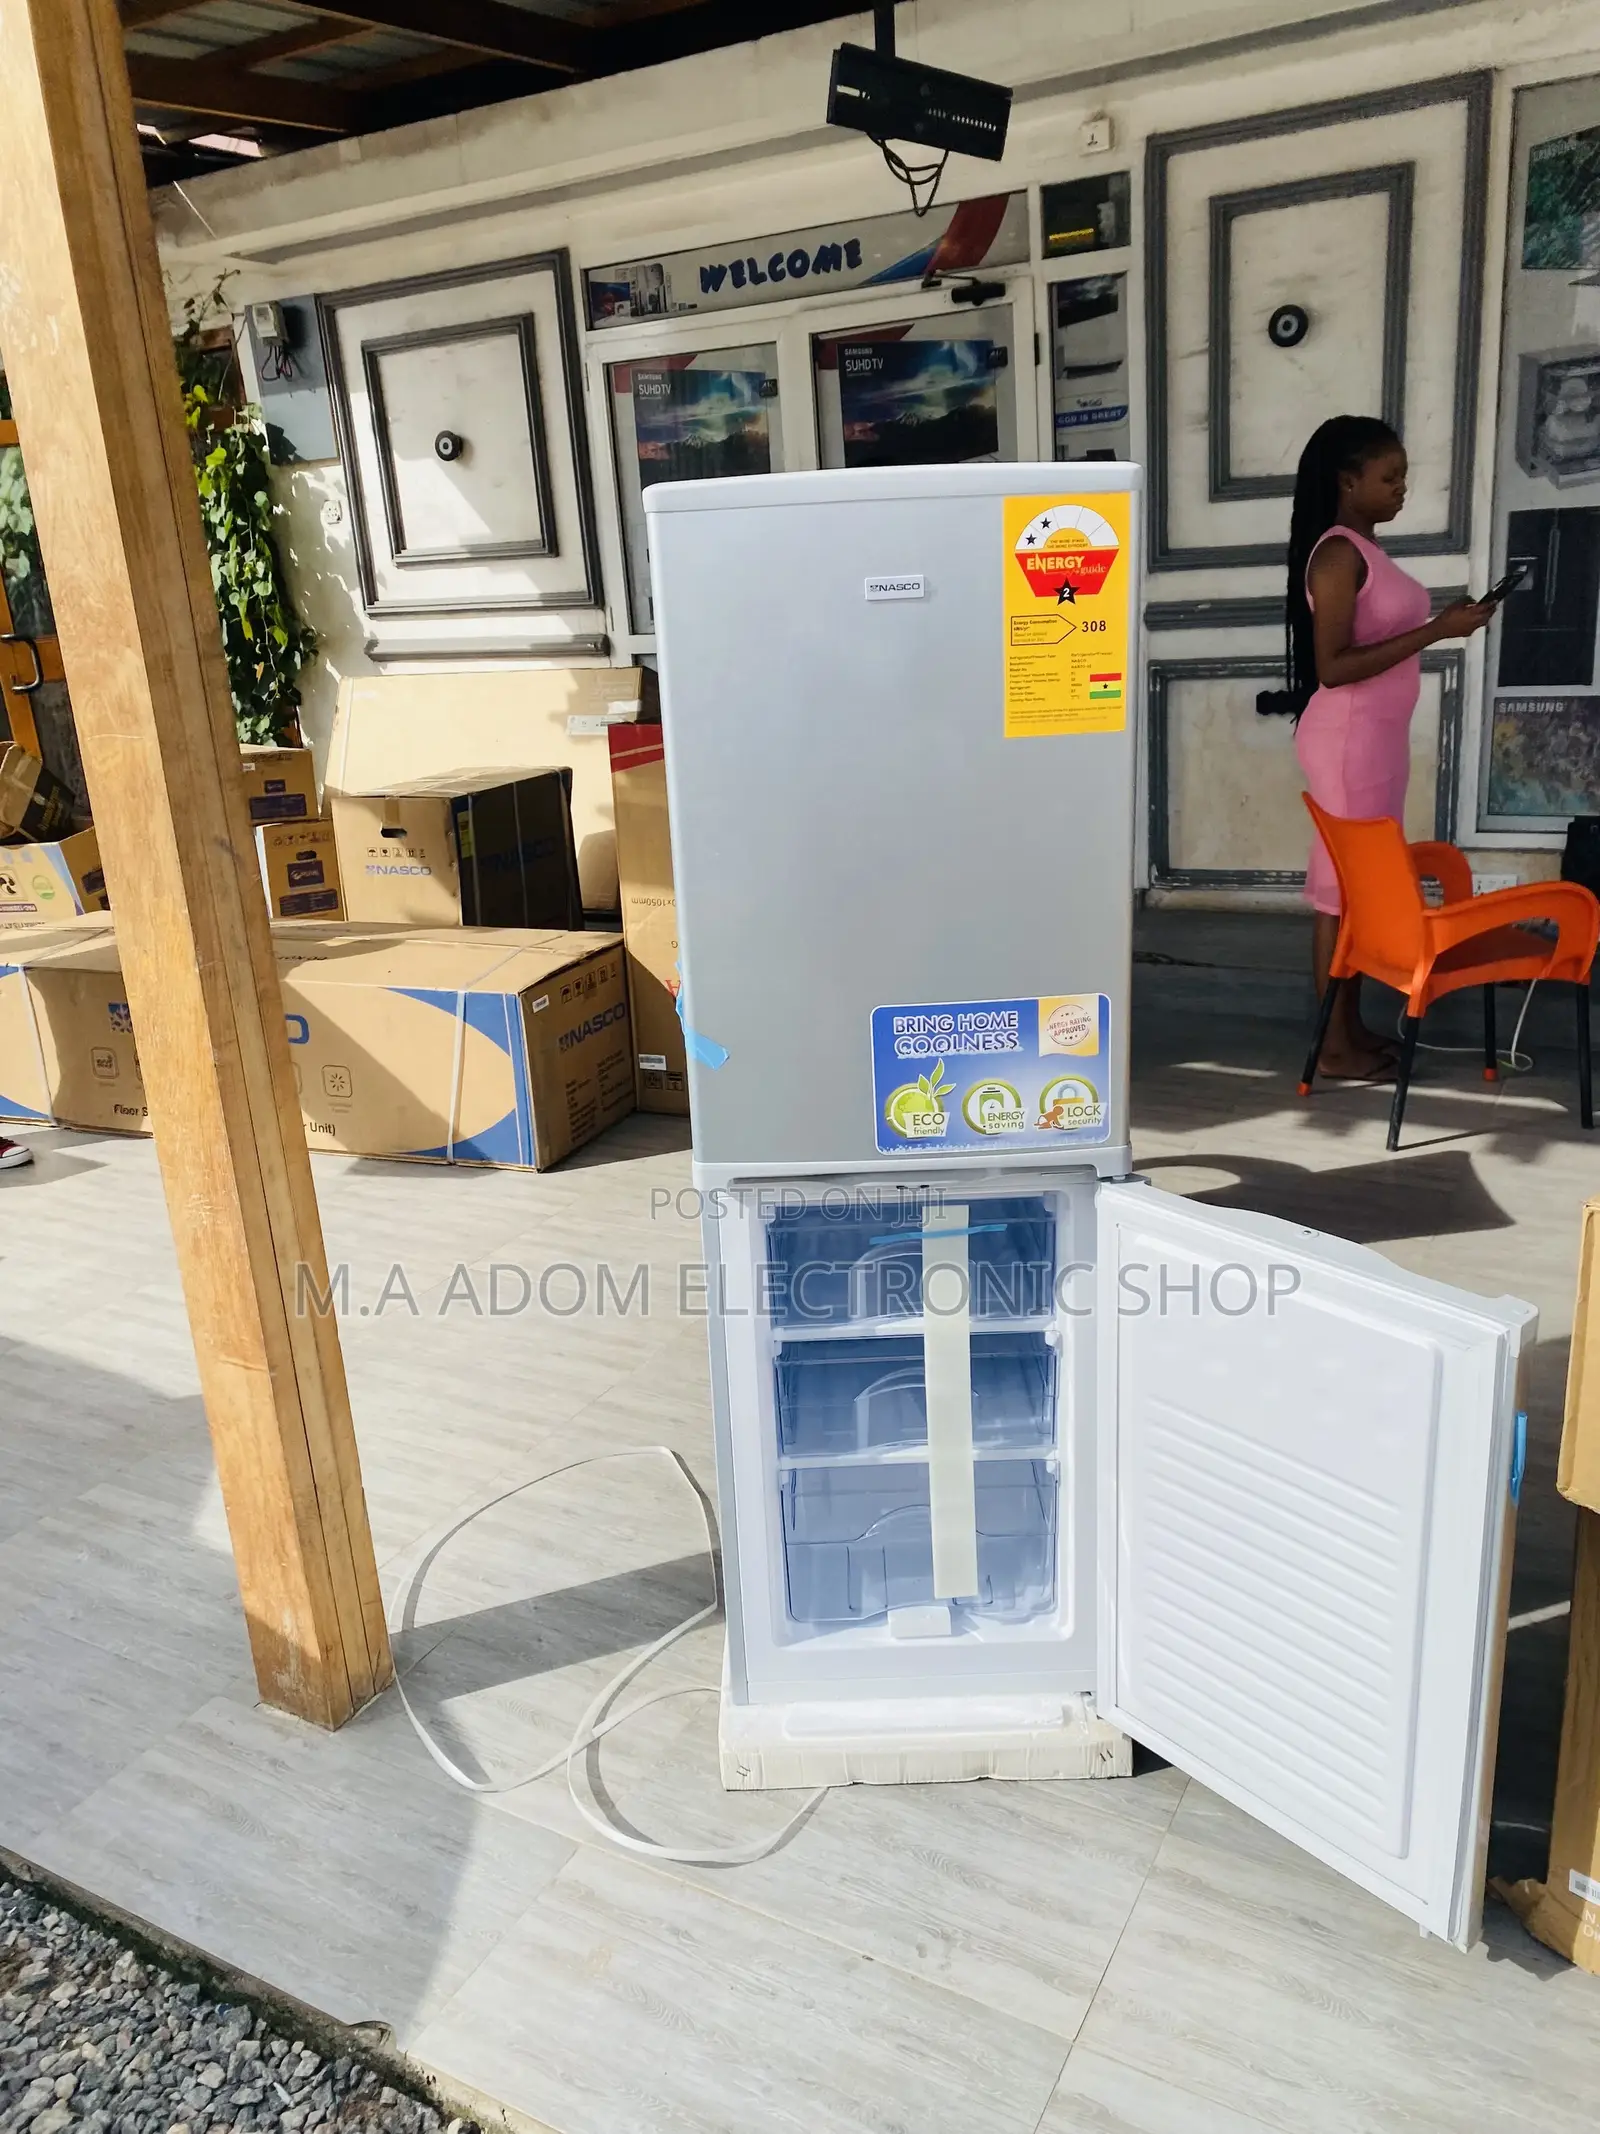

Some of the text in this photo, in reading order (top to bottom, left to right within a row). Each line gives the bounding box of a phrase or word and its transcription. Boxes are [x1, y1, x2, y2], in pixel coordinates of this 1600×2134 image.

[699, 237, 863, 294] WELCOME
[1026, 553, 1086, 575] ENERGY
[1080, 563, 1107, 576] guide
[879, 582, 921, 592] NASCO
[1062, 587, 1070, 598] 2
[1081, 619, 1107, 633] 308
[1499, 702, 1564, 713] SAMSUNG
[376, 865, 432, 876] NASCO
[569, 1002, 626, 1049] NASCO
[894, 1009, 1019, 1035] BRING HOME
[1069, 1015, 1092, 1026] RATING
[1053, 1023, 1087, 1037] APPROVED
[894, 1031, 1020, 1056] COOLNESS
[113, 1103, 139, 1116] Floor
[987, 1110, 1026, 1122] ENERGY
[1067, 1104, 1102, 1118] LOCK
[912, 1113, 945, 1126] ECO
[988, 1121, 1025, 1131] saving
[1067, 1116, 1103, 1127] security
[309, 1122, 336, 1137] Unit)
[913, 1126, 945, 1136] friendly
